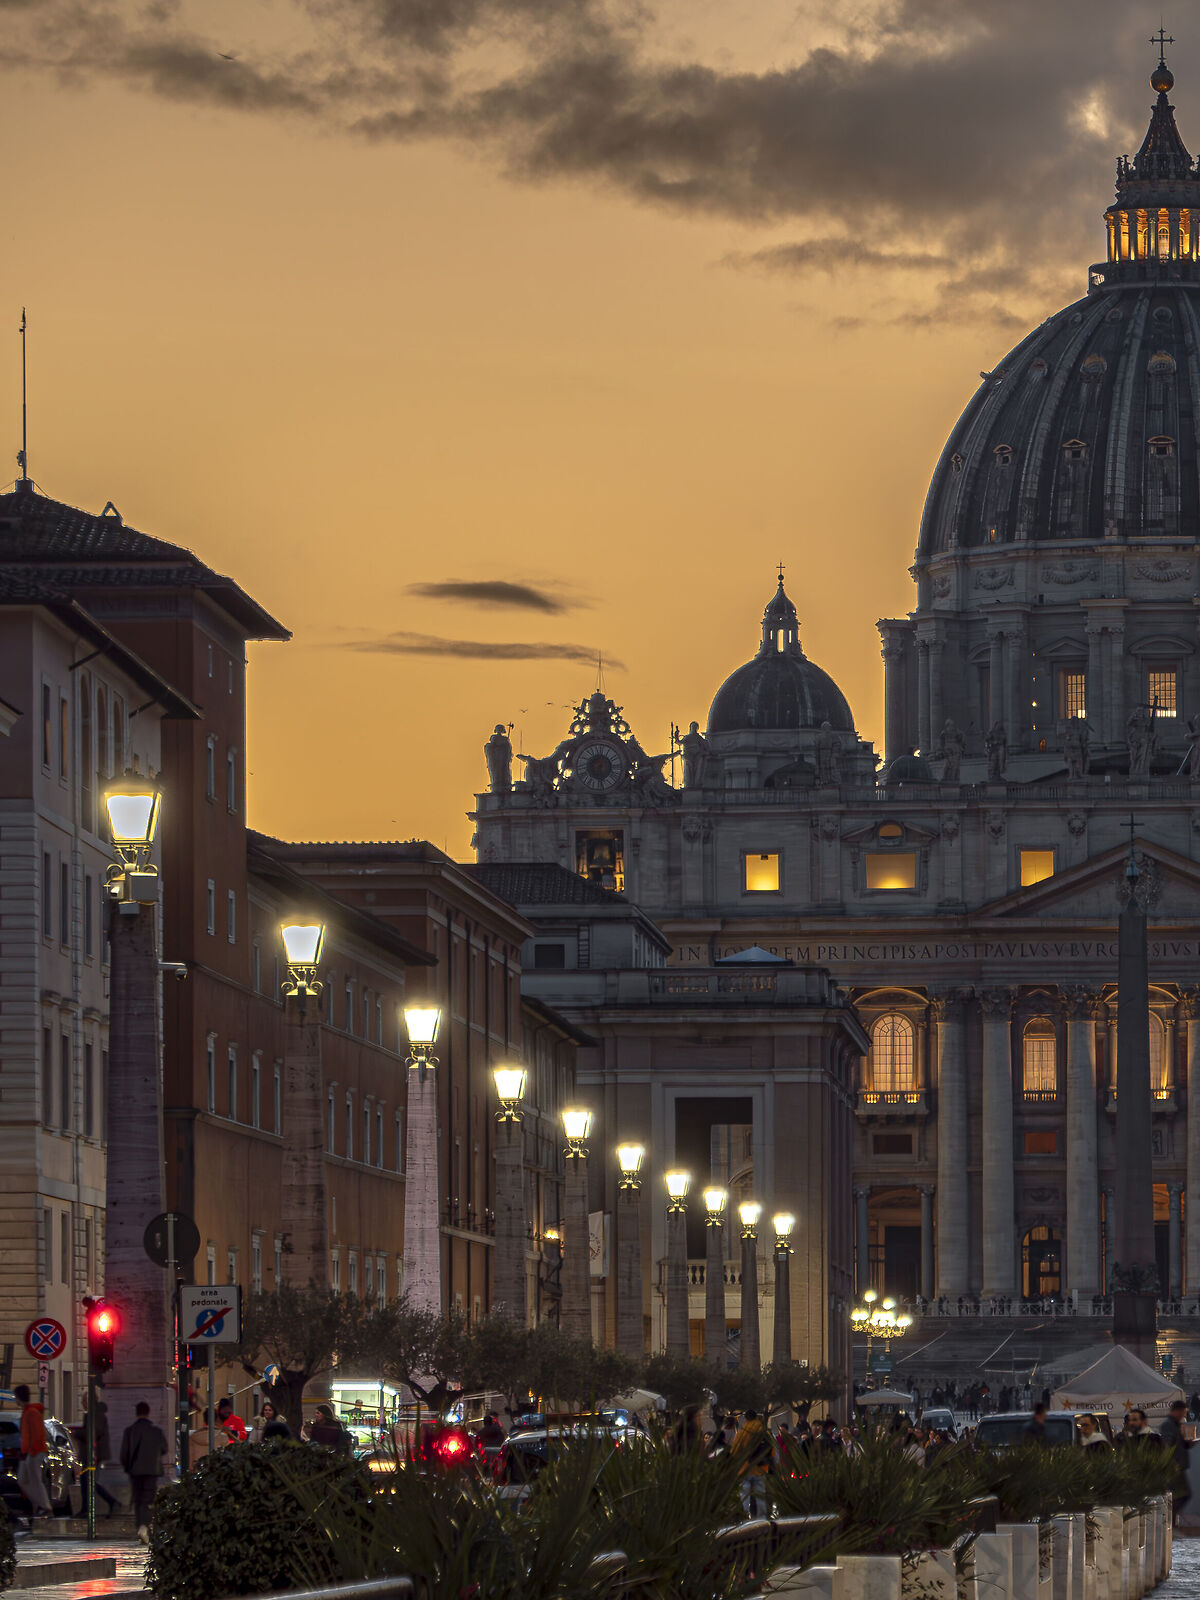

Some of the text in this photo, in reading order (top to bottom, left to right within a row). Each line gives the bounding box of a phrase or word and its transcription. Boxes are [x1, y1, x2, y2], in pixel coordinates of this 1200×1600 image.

[679, 946, 700, 960] IN
[817, 945, 916, 960] PRINCIPIS
[984, 943, 1048, 957] PAVLVS
[1053, 943, 1064, 957] V
[1076, 1402, 1113, 1410] ESERCITO
